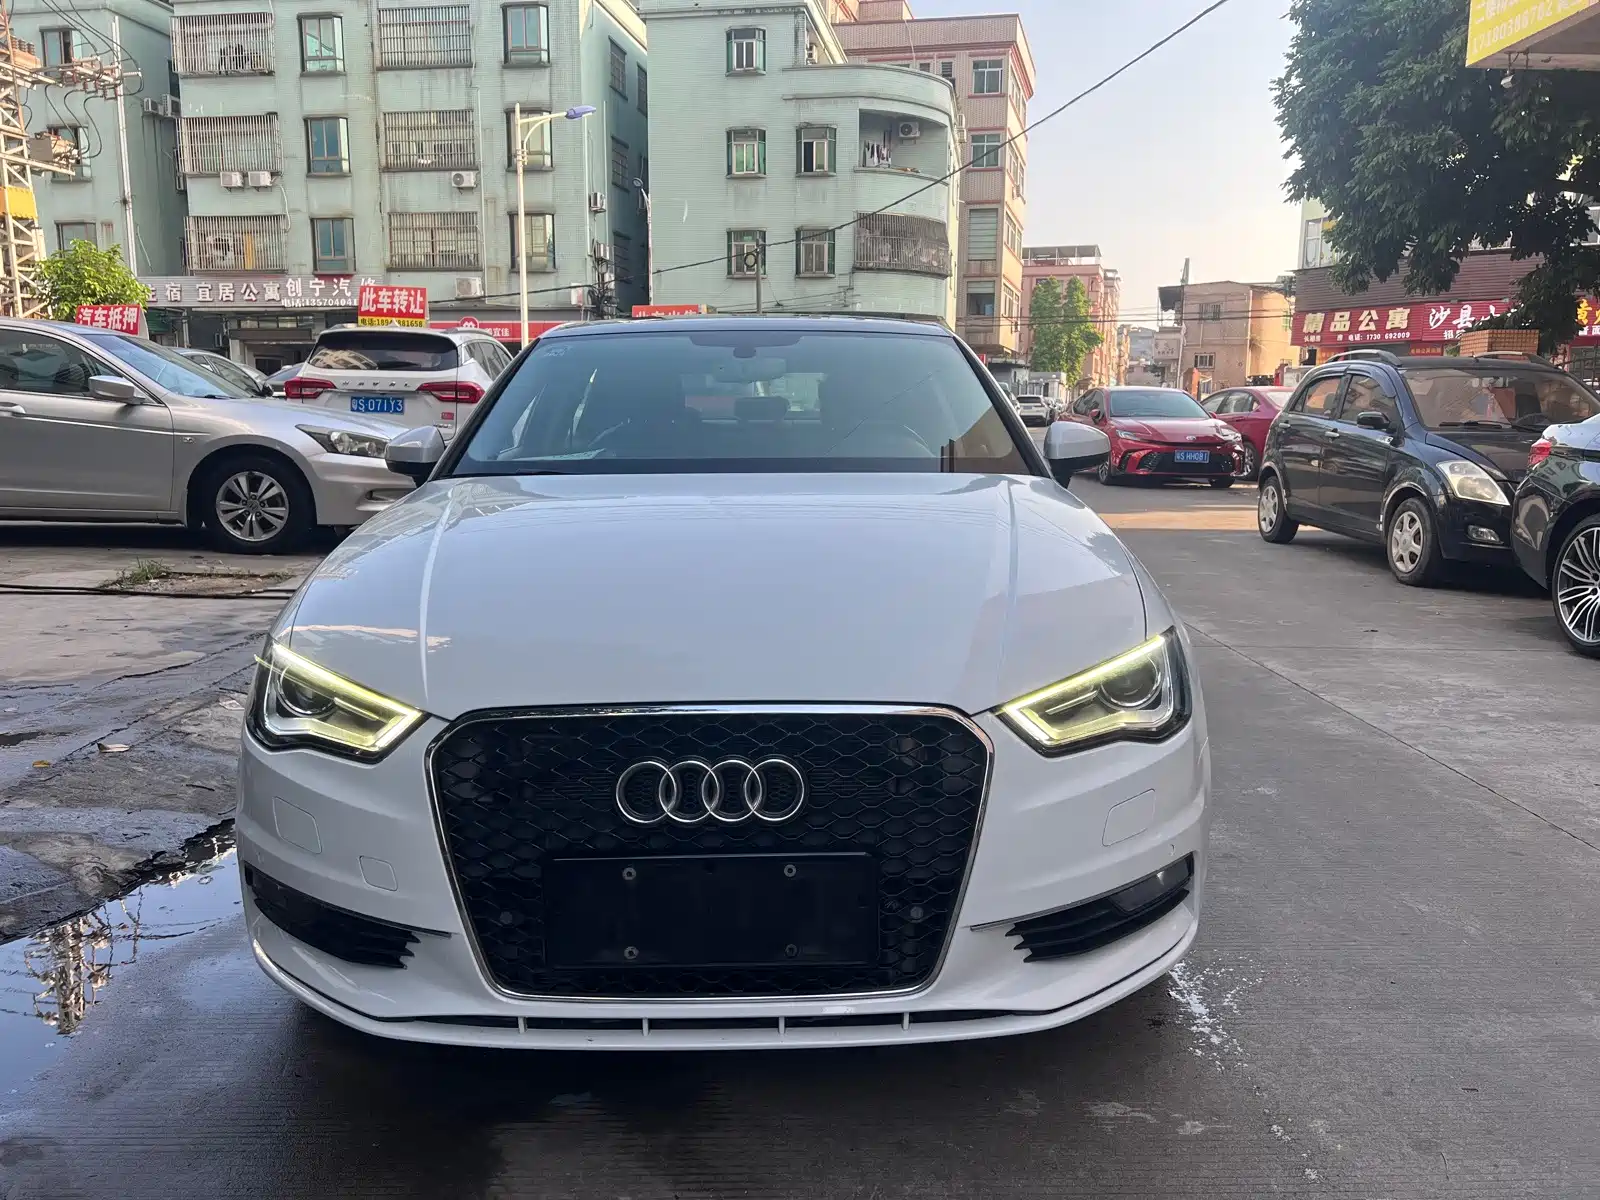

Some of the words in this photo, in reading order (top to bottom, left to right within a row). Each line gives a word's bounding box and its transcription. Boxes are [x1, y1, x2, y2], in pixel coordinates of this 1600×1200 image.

[196, 280, 281, 302] 宜居公寓
[360, 287, 424, 314] 此车转让
[78, 307, 138, 331] 汽车抵押
